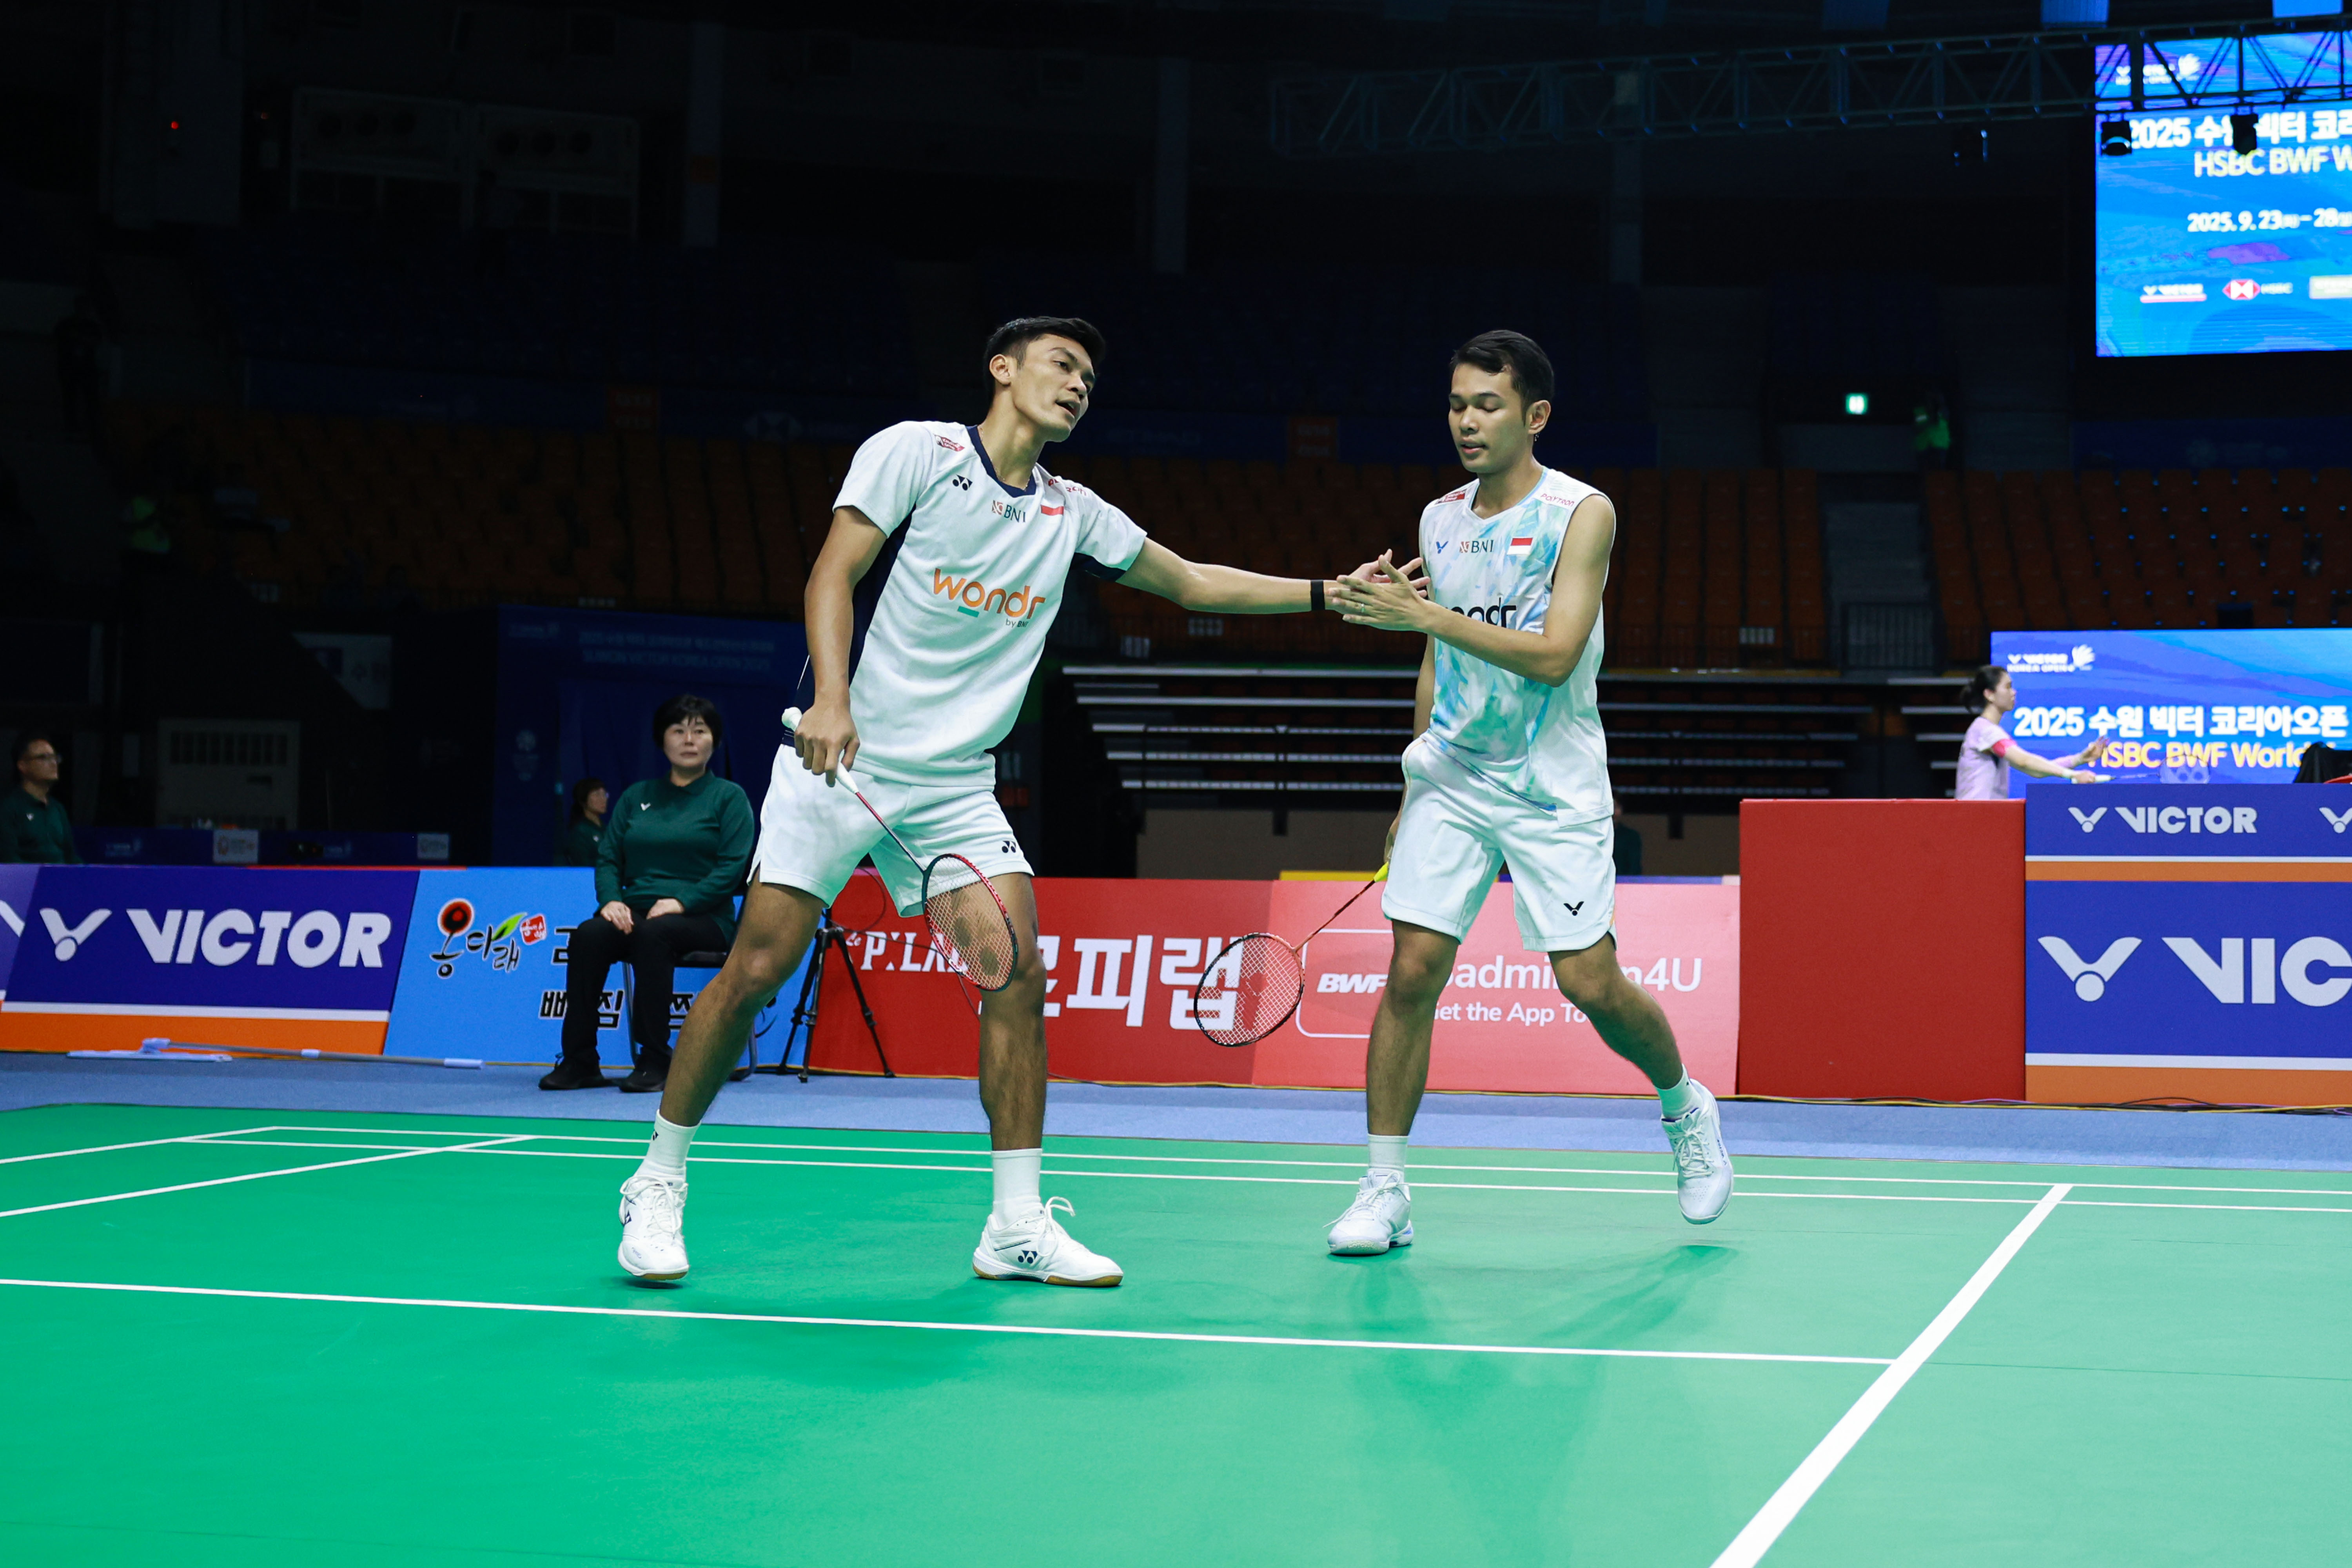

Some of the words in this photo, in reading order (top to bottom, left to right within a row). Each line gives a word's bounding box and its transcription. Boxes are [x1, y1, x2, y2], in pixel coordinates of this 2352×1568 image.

[2194, 149, 2265, 177] HSBC
[2269, 146, 2329, 174] BWF
[1004, 504, 1026, 523] BNI
[1471, 539, 1494, 553] BNI
[933, 568, 1046, 620] wondr
[1005, 618, 1016, 628] by
[1445, 597, 1516, 628] ndr
[2014, 707, 2085, 737] 2025
[2089, 706, 2143, 737] 수원
[2150, 706, 2204, 737] 빅터
[2209, 705, 2349, 737] 코리아오픈
[2166, 742, 2227, 768] BWF
[2114, 806, 2257, 834] VICTOR
[126, 909, 391, 968] VICTOR
[978, 935, 1244, 1030] 피랩
[1317, 973, 1388, 993] BWF
[2161, 936, 2352, 1007] VIC
[1466, 1002, 1501, 1022] the
[1506, 1002, 1555, 1027] App
